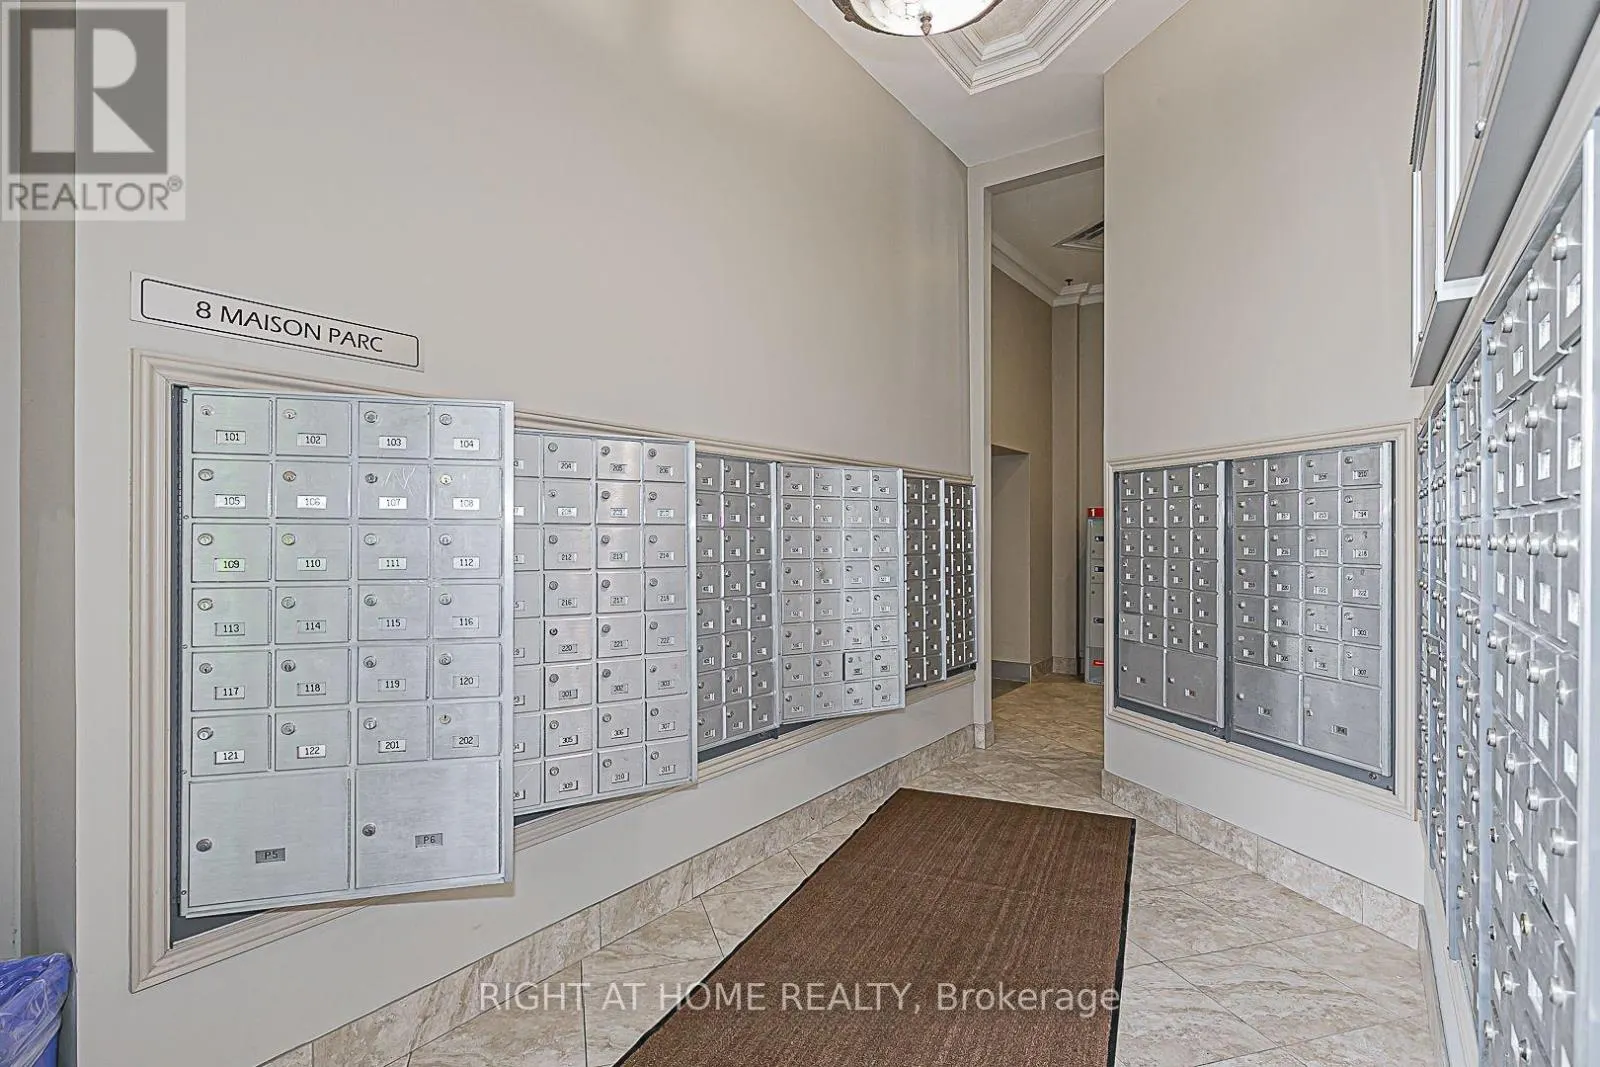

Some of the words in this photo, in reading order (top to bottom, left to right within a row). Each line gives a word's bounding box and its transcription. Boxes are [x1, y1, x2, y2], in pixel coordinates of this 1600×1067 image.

[196, 300, 211, 319] 8
[220, 304, 321, 341] MAISON
[329, 327, 383, 353] PARC
[224, 432, 240, 442] 101
[304, 434, 321, 445] 102
[386, 438, 402, 447] 103
[459, 439, 474, 449] 104
[223, 496, 240, 506] 105
[459, 557, 474, 567] 112
[561, 553, 572, 561] 212
[304, 558, 321, 569] 110
[385, 558, 401, 568] 111
[561, 599, 573, 607] 216
[304, 621, 321, 631] 114
[385, 618, 401, 628] 115
[458, 617, 474, 627] 116
[223, 623, 240, 633] 113
[561, 644, 573, 652] 220
[613, 640, 623, 648] 221
[385, 679, 401, 689] 119
[459, 676, 474, 686] 120
[223, 687, 239, 697] 117
[304, 683, 321, 693] 118
[613, 728, 625, 736] 306
[385, 740, 400, 750] 201
[458, 735, 474, 745] 202
[562, 736, 574, 744] 305
[223, 751, 239, 761] 121
[304, 746, 321, 756] 122
[422, 835, 436, 845] P6
[264, 850, 279, 860] P5
